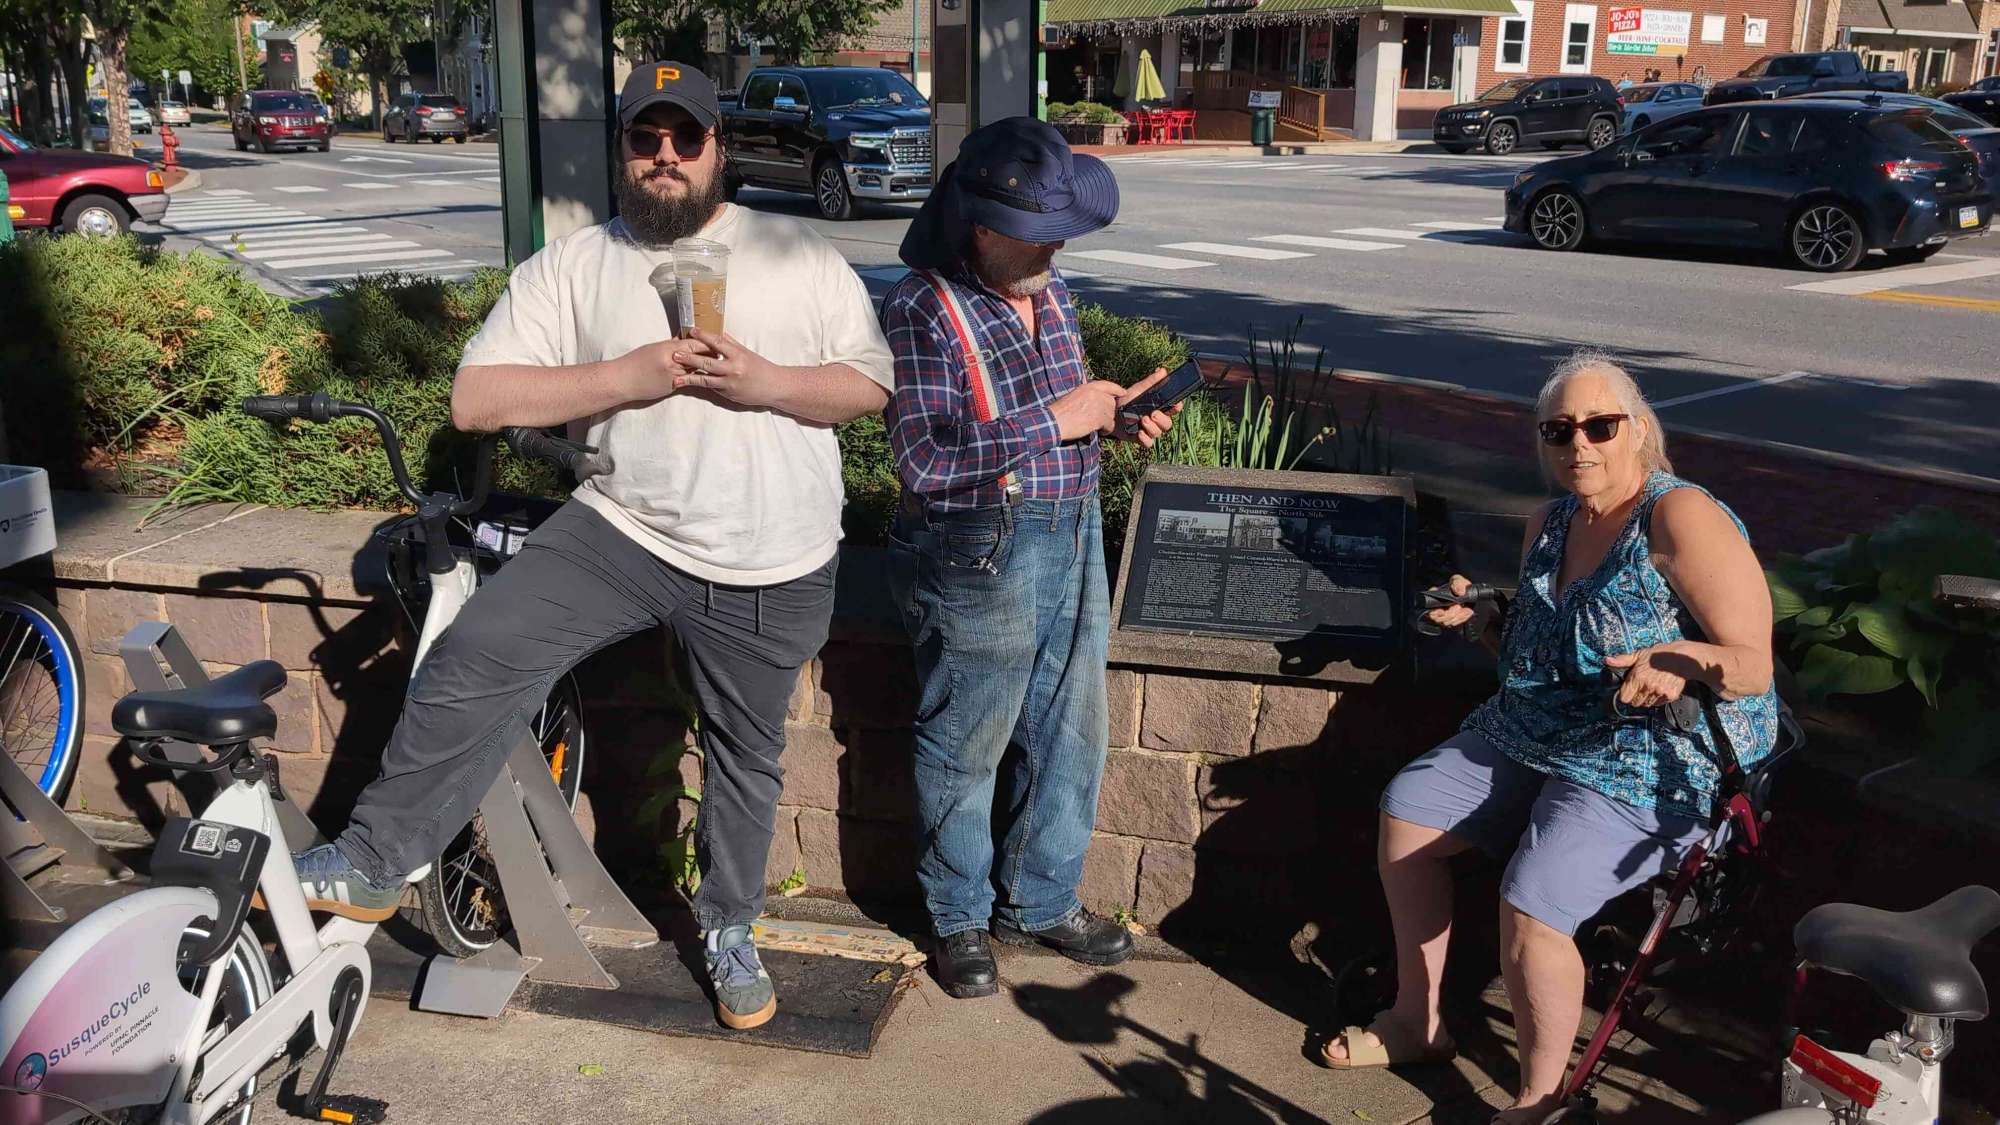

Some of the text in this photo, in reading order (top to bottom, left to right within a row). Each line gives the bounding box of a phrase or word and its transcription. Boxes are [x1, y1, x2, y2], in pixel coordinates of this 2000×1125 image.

[1613, 20, 1637, 32] PIZZA
[656, 66, 680, 90] P
[1207, 492, 1340, 510] THEN AND NOW
[1219, 505, 1236, 513] The
[1238, 506, 1269, 516] Square
[49, 980, 151, 1067] SusqueCycle
[129, 1005, 159, 1032] PINNACLE
[84, 1025, 122, 1057] POWERED BY
[111, 1020, 152, 1057] FOUNDATION
